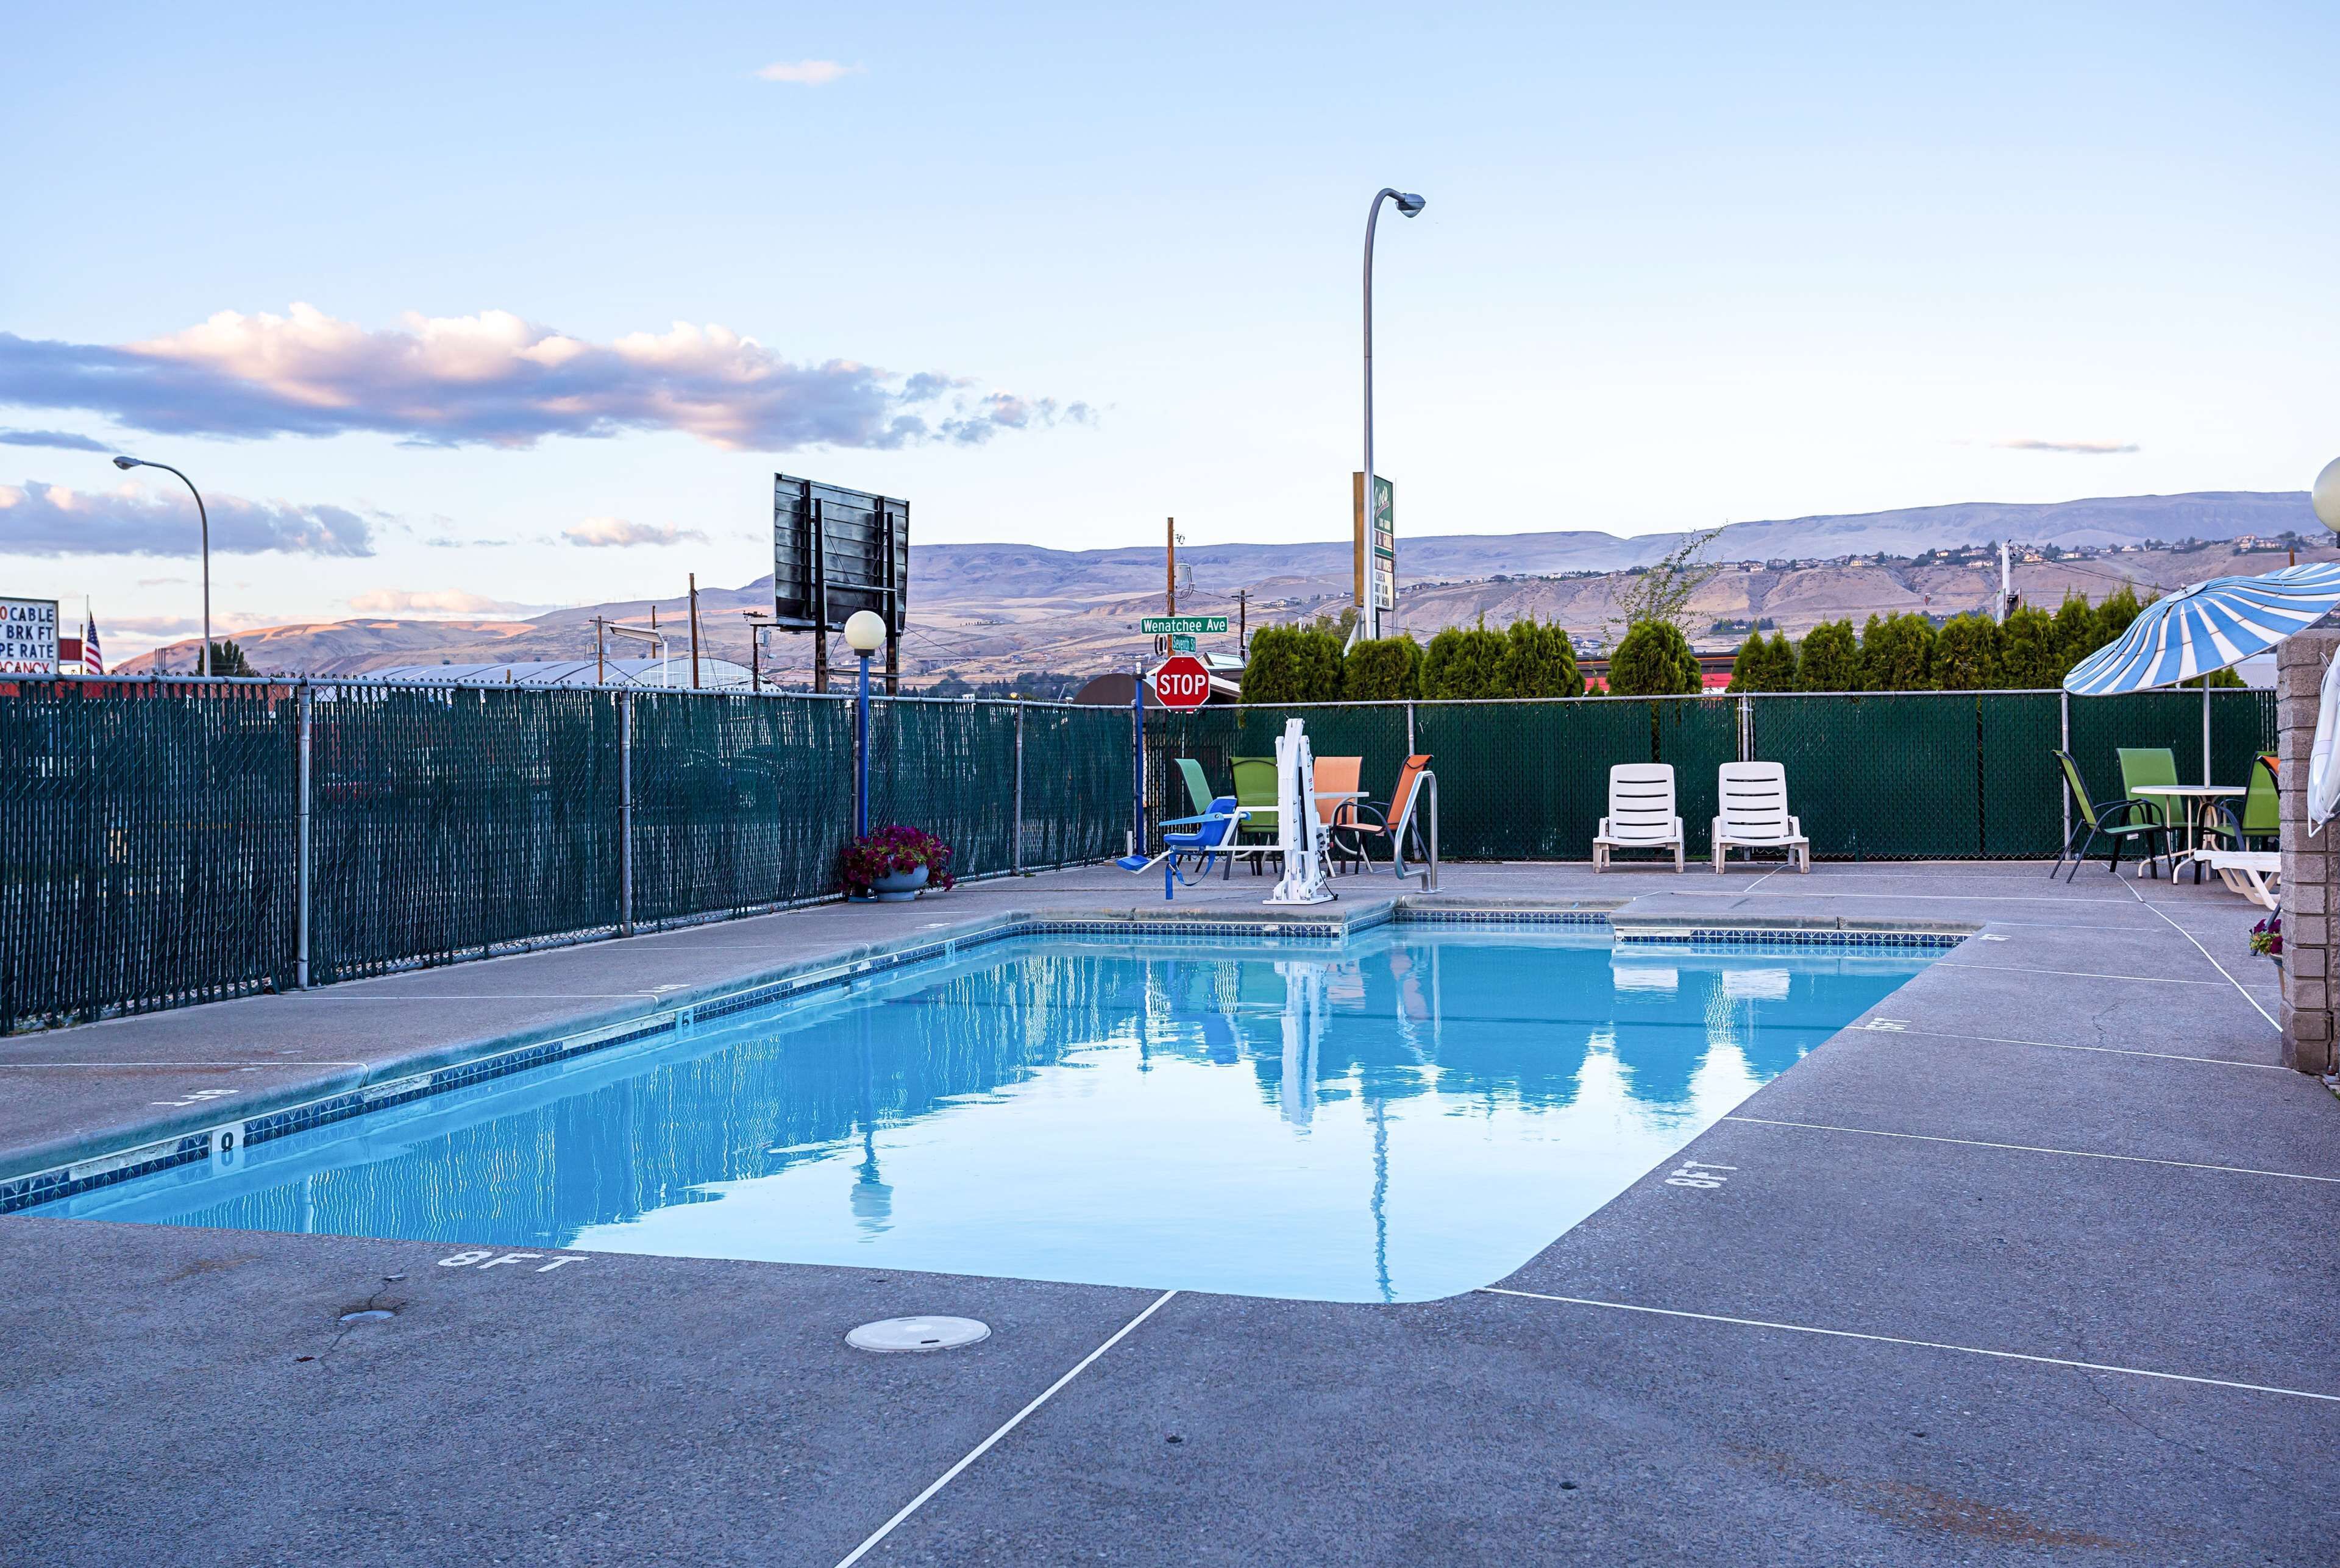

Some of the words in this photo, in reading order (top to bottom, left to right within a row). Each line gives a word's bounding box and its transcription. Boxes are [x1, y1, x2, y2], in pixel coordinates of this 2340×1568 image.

[10, 607, 54, 622] CABLE
[1143, 619, 1201, 632] Wenatchee
[1206, 619, 1226, 631] Ave
[20, 644, 54, 658] RATE
[1173, 636, 1190, 650] Seventh
[1190, 638, 1195, 651] St
[1159, 674, 1206, 695] STOP
[1665, 1161, 1738, 1188] 8FT
[438, 1250, 591, 1272] 8FT
